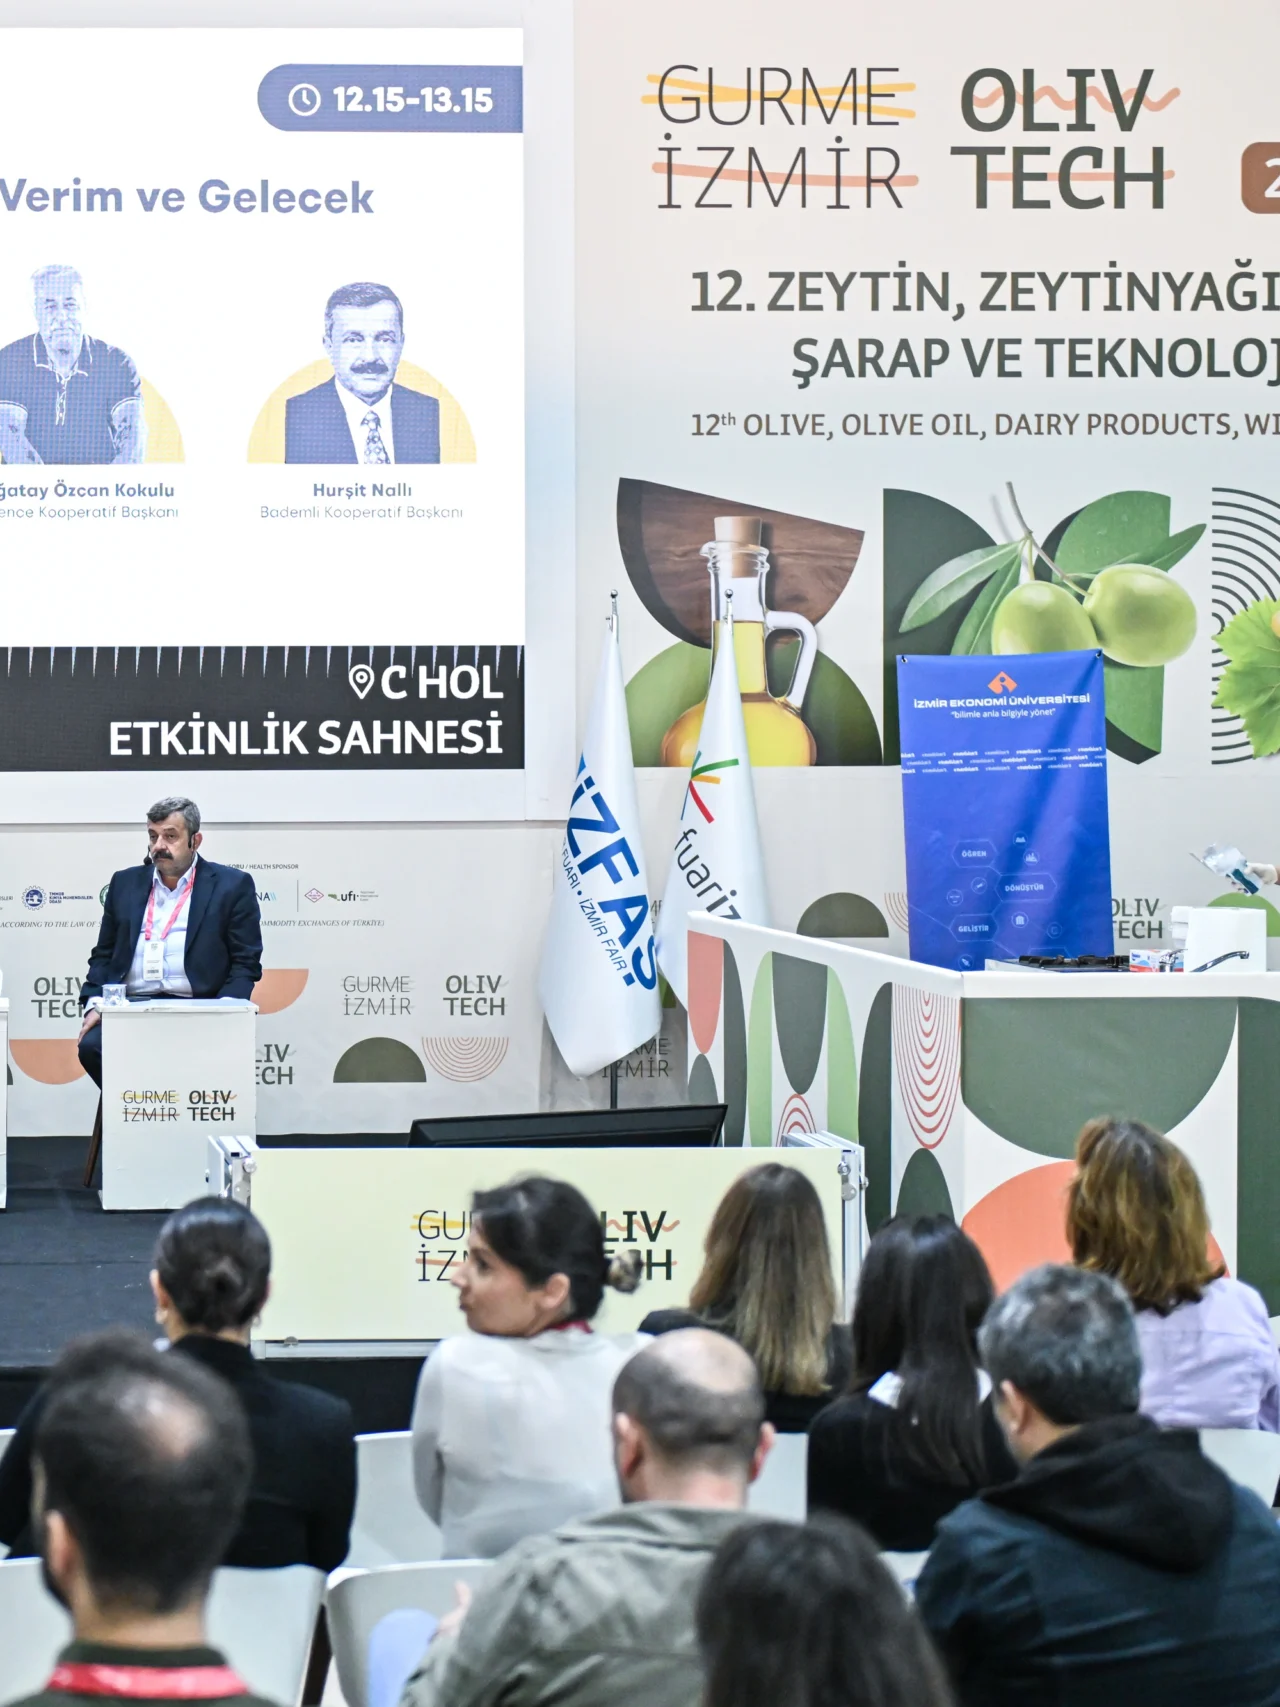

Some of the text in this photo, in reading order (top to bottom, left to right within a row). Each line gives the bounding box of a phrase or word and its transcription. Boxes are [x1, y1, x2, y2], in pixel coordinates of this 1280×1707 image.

[657, 64, 900, 126] GURME
[960, 66, 1155, 133] OLIV
[657, 132, 903, 210] İZMİR
[950, 145, 1165, 210] TECH
[136, 187, 185, 213] ve
[198, 177, 374, 214] Gelecek
[691, 258, 1280, 321] 12. ZEYTİN, ZEYTİNYAĞI
[792, 338, 950, 390] ŞARAP
[961, 338, 1022, 379] VE
[691, 412, 737, 437] 12th
[743, 413, 834, 440] OLIVE,
[841, 413, 924, 437] OLIVE
[931, 413, 987, 440] OIL,
[995, 413, 1078, 437] DAIRY
[1087, 413, 1239, 440] PRODUCTS,
[115, 483, 175, 498] Kokulu
[313, 482, 412, 500] Hurşit Nallı
[39, 505, 117, 521] Kooperatif
[122, 505, 179, 520] Başkanı
[260, 505, 463, 521] Bademli Kooperatif Başkanı
[381, 665, 504, 699] C HOL
[913, 693, 1090, 709] İZMİR EKONOMİ ÜNİVERSİTESİ
[982, 710, 1000, 718] anla
[1001, 710, 1029, 719] bilgiyle
[110, 711, 503, 756] ETKİNLİK SAHNESİ
[578, 898, 608, 937] İZMİR
[601, 937, 628, 971] FAIR
[1113, 920, 1163, 939] ECH
[343, 974, 410, 993] GURME
[445, 974, 502, 994] OLIV
[343, 992, 411, 1016] İZMİR
[443, 997, 506, 1016] TECH
[123, 1090, 177, 1105] GURME
[188, 1090, 232, 1106] OLIV
[123, 1105, 178, 1122] İZMİR
[187, 1106, 234, 1121] TECH
[600, 1210, 667, 1242] LIV
